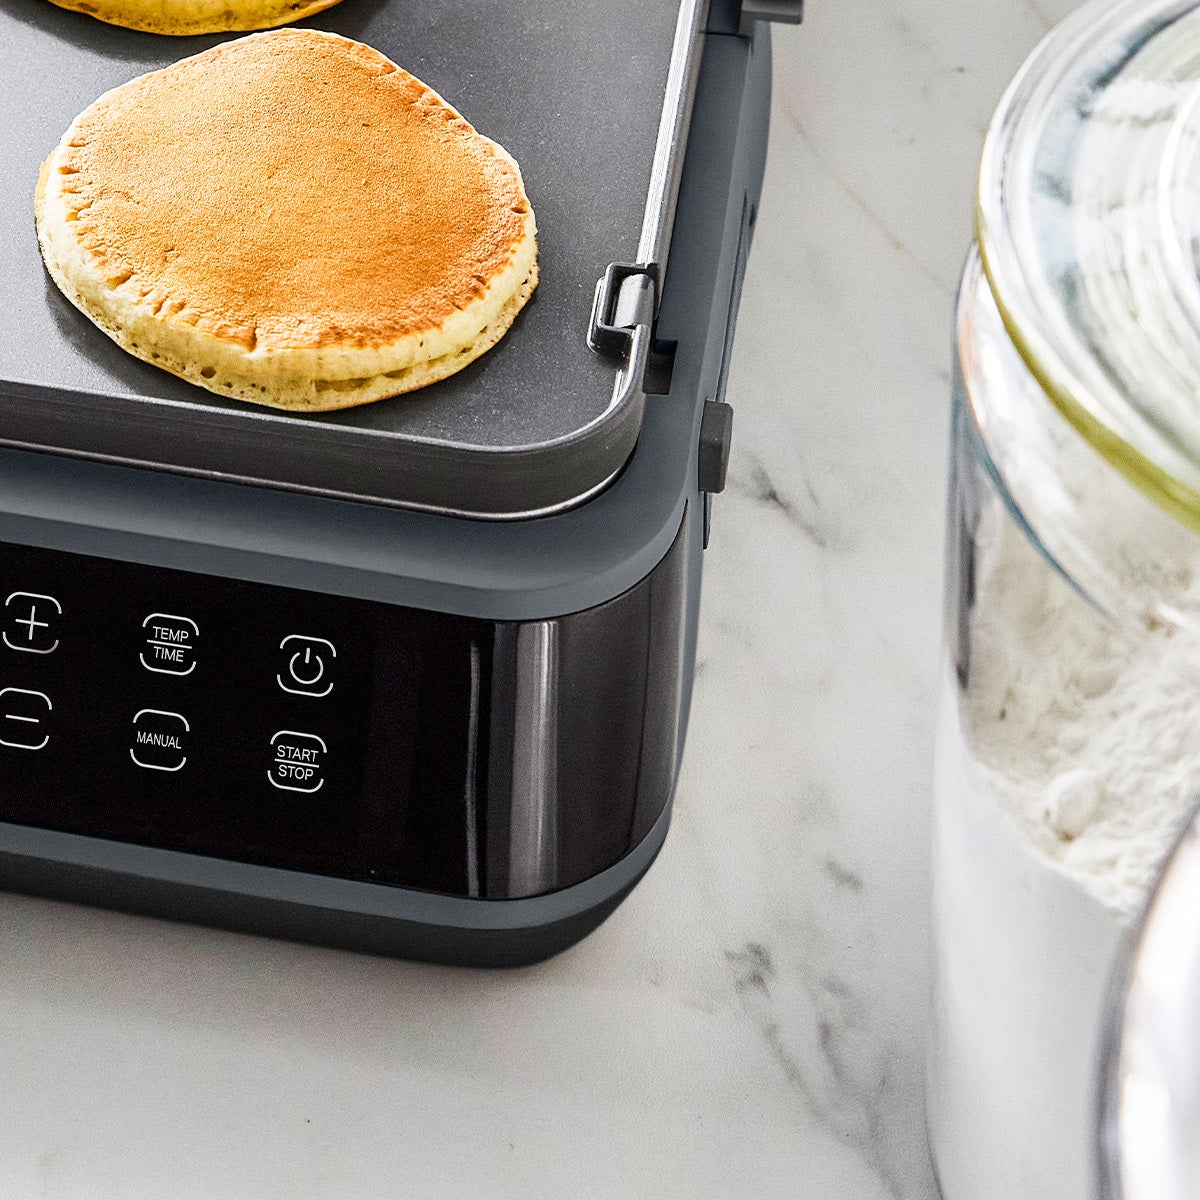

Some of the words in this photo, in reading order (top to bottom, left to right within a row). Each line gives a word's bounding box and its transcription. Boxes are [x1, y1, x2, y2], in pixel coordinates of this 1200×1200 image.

[152, 625, 189, 643] TEMP
[153, 646, 184, 663] TIME
[136, 730, 182, 750] MANUAL
[276, 744, 319, 763] START
[278, 763, 315, 781] STOP
